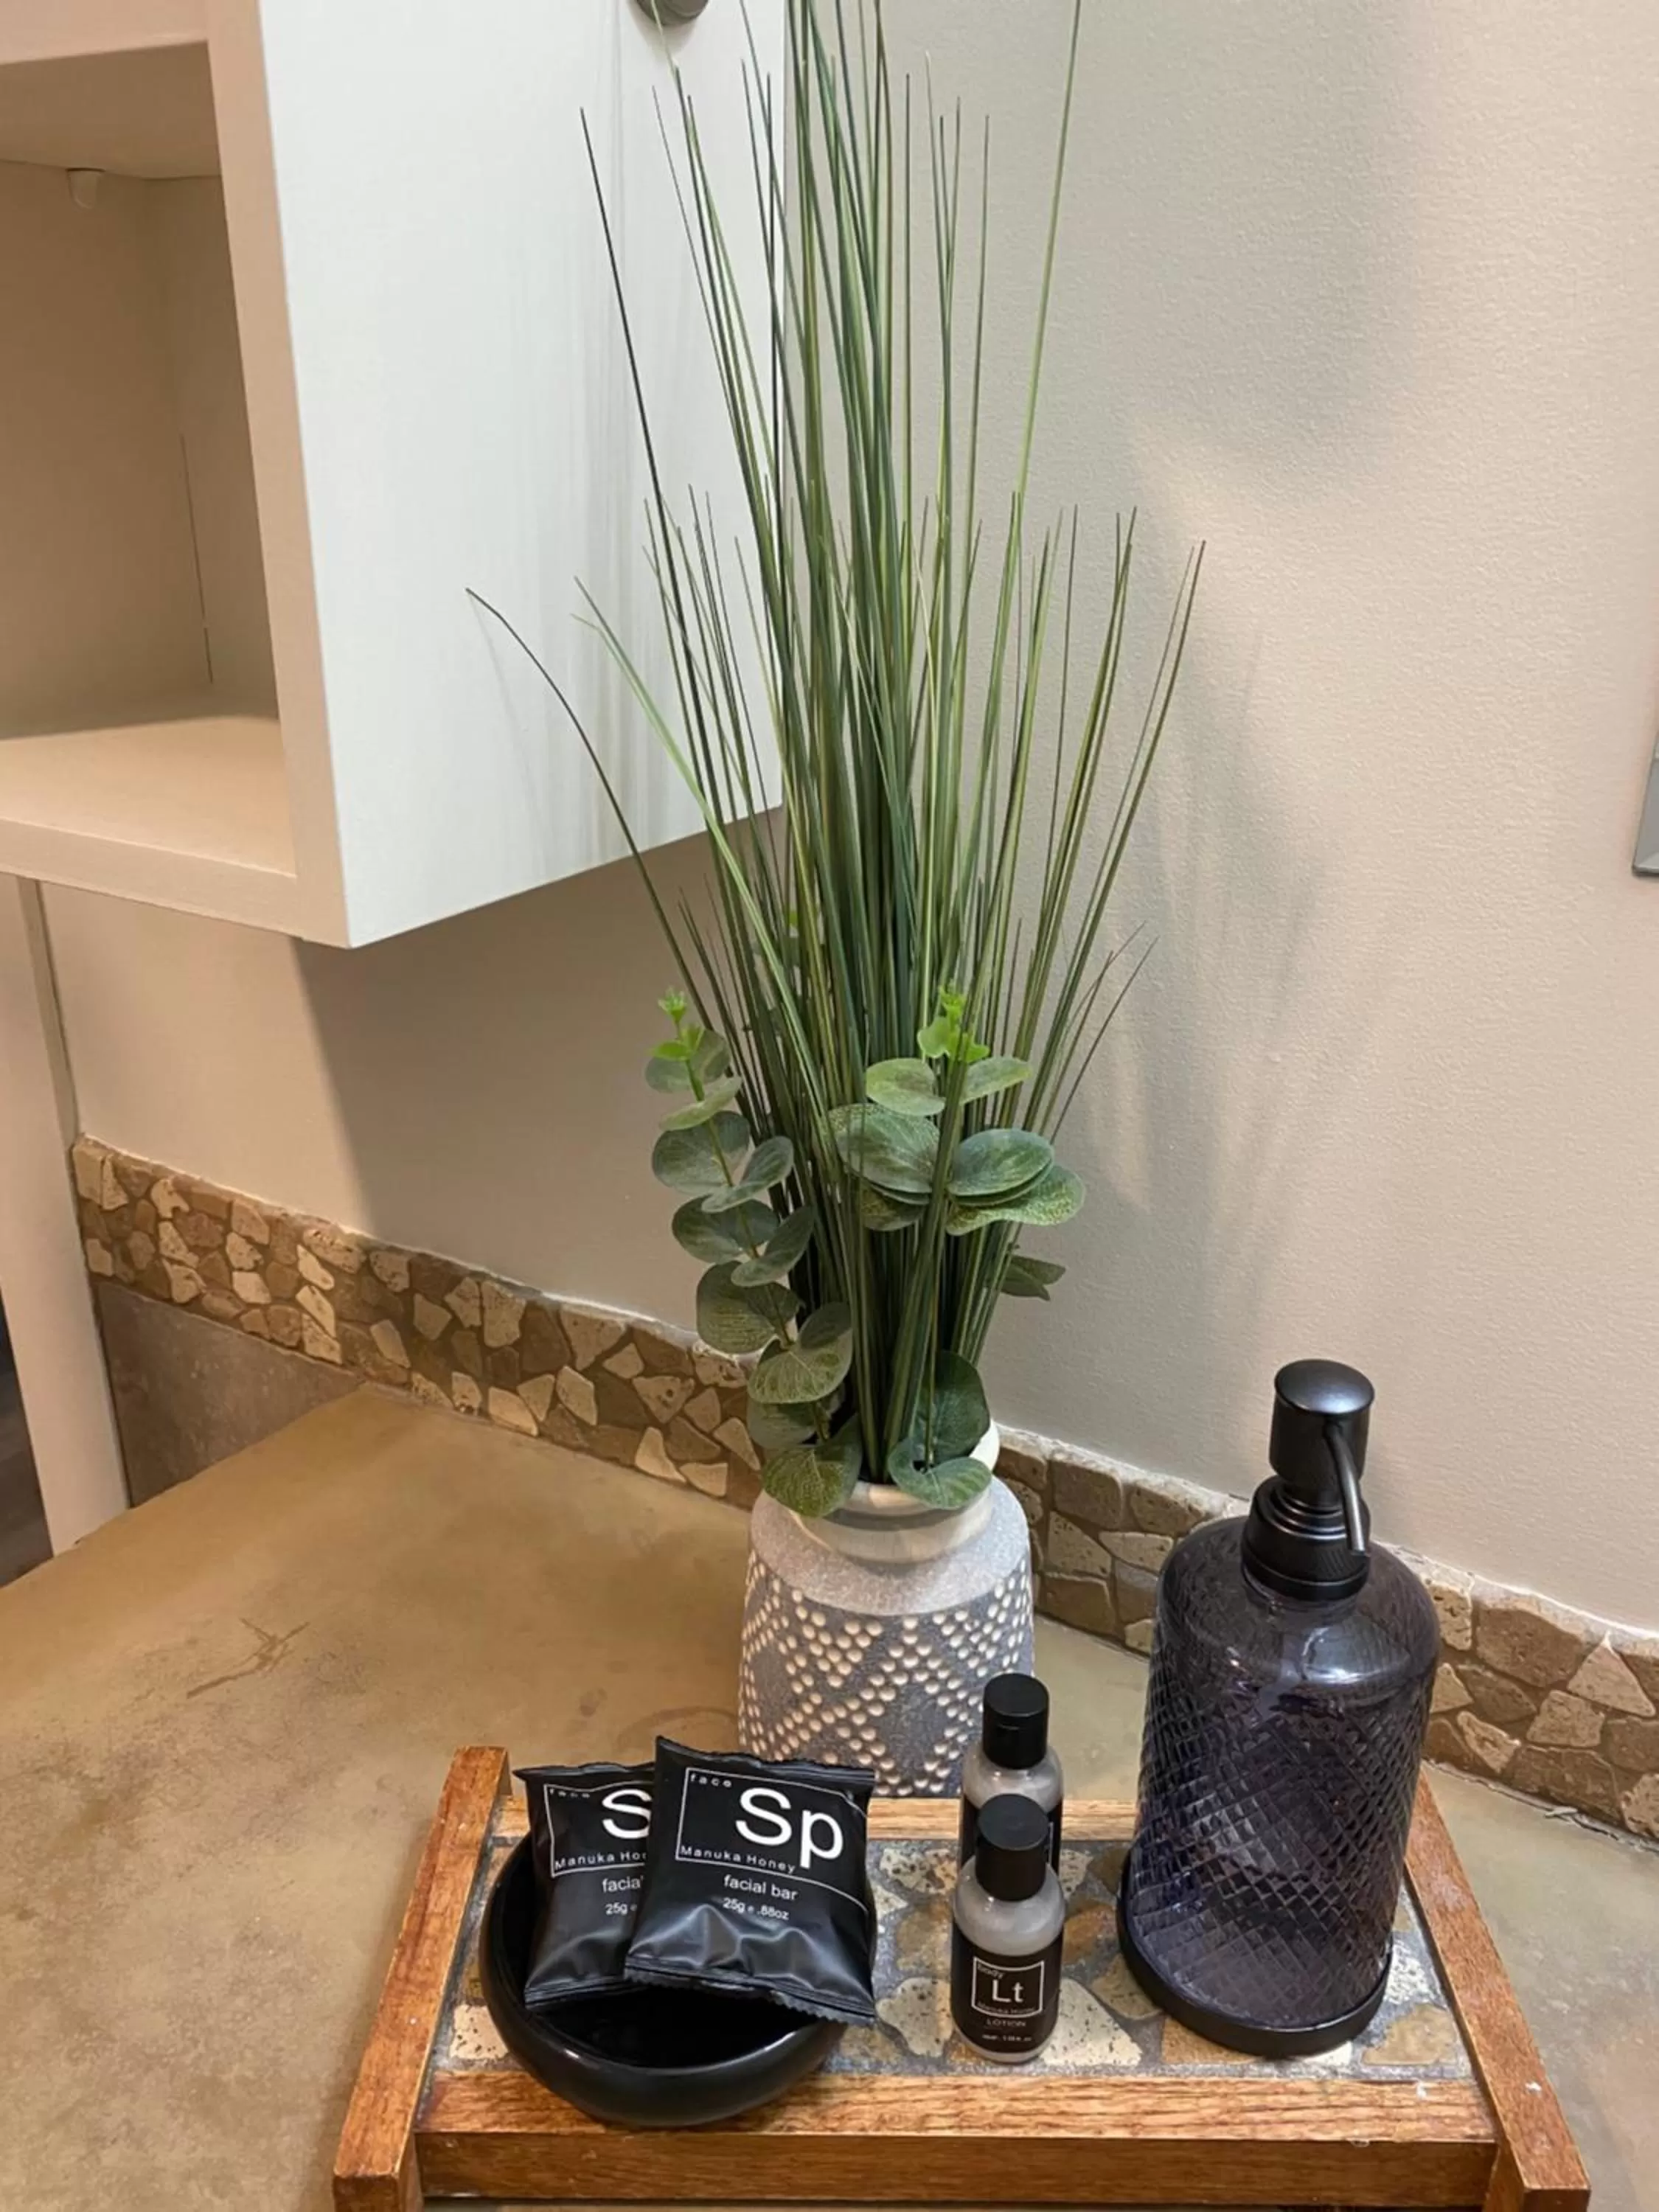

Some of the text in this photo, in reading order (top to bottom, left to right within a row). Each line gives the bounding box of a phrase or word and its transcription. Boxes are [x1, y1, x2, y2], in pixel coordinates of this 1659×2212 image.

[735, 1787, 844, 1869] Sp
[554, 1852, 615, 1870] Manuka
[680, 1846, 796, 1874] Manuka Honey
[723, 1874, 798, 1901] facial bar
[605, 1902, 628, 1916] 25g
[723, 1897, 745, 1914] 25g
[992, 1979, 1024, 2003] Lt
